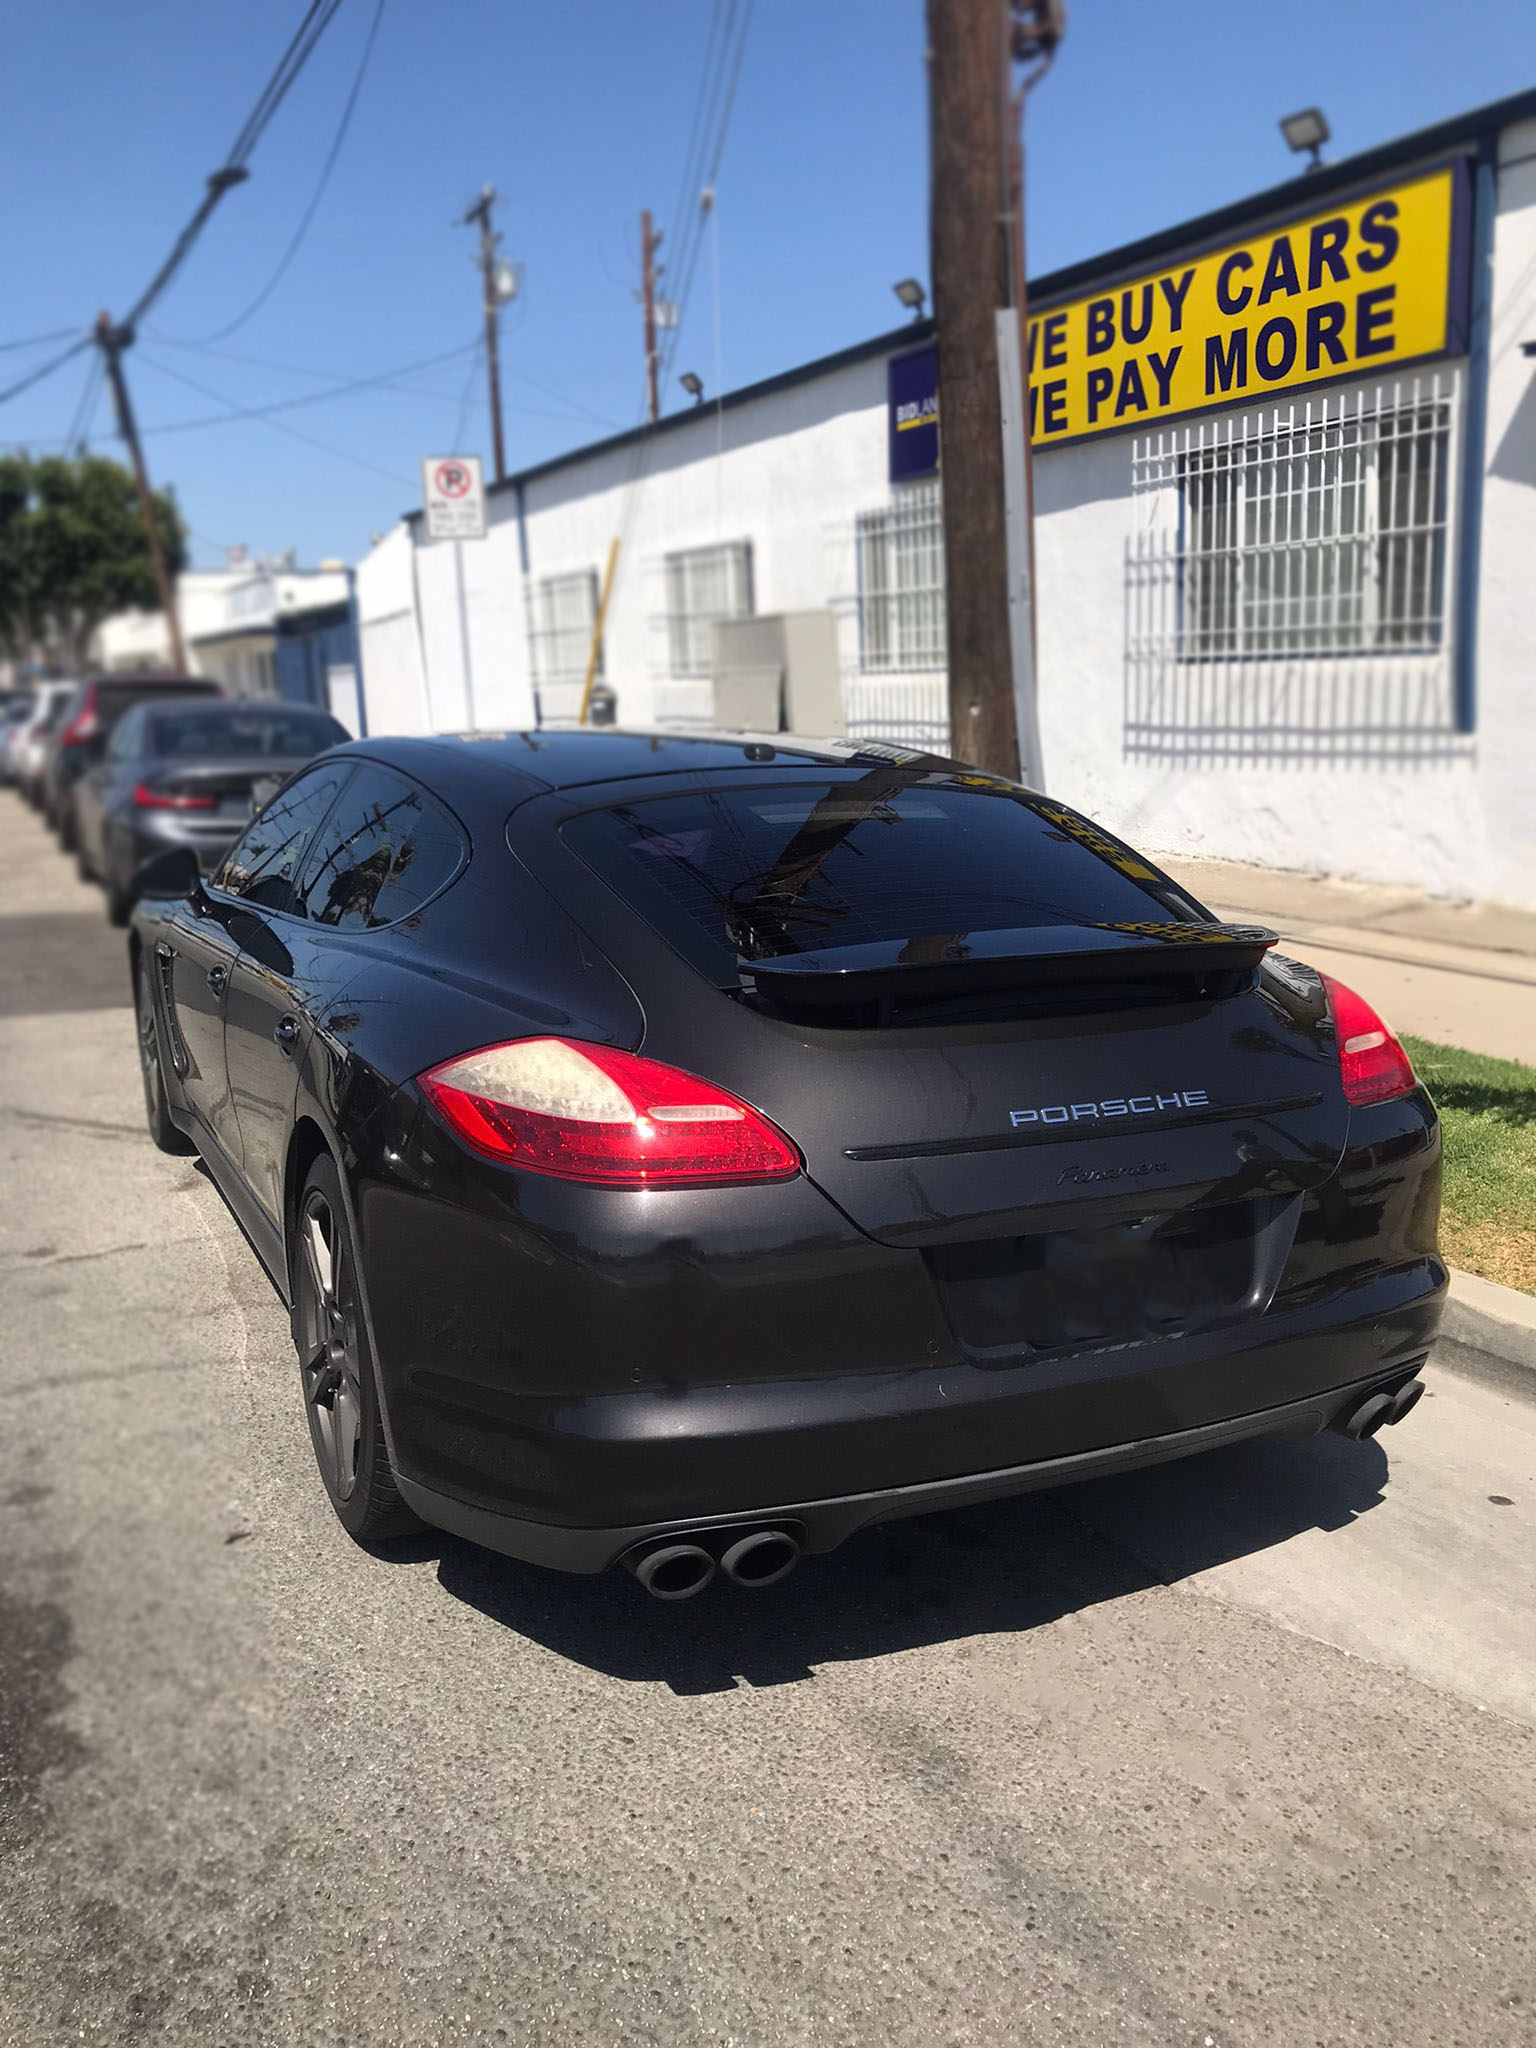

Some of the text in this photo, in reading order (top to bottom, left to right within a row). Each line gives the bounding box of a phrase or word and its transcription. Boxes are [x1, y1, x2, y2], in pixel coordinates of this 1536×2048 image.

[1087, 268, 1196, 357] BUY
[1216, 200, 1400, 316] CARS
[1087, 345, 1184, 424] PAY
[1205, 283, 1397, 396] MORE
[1009, 1089, 1209, 1128] PORSCHE
